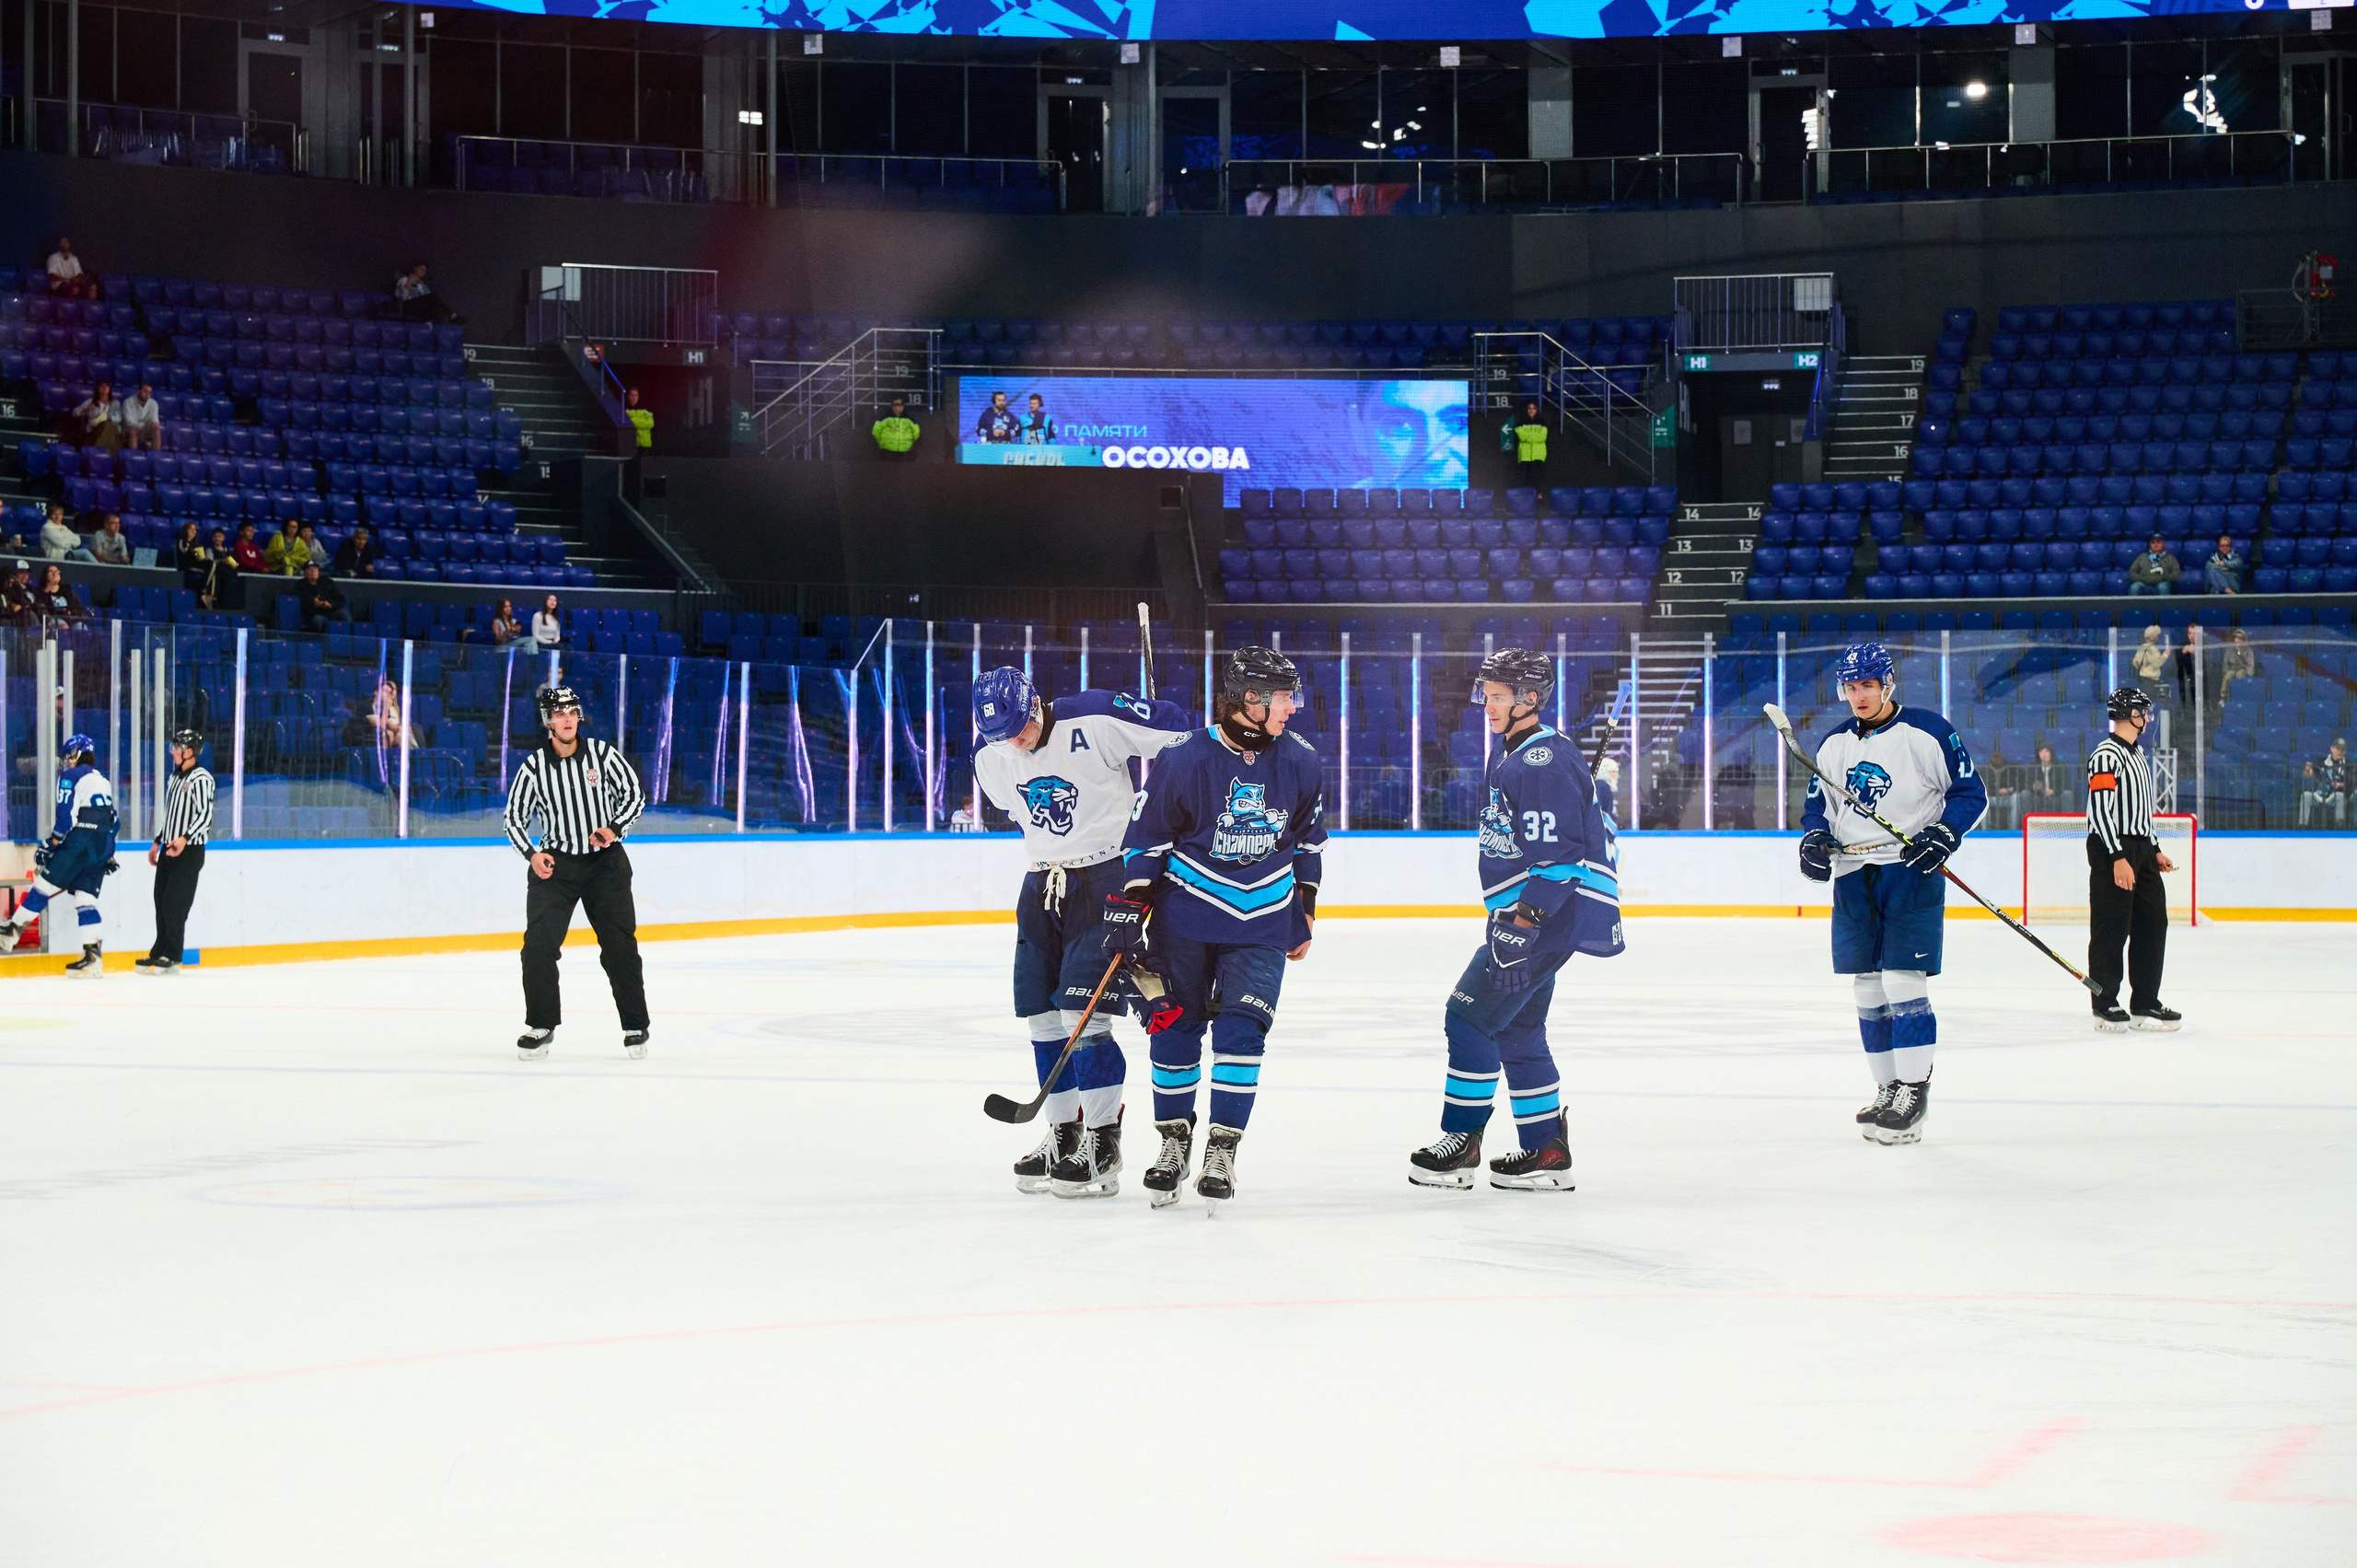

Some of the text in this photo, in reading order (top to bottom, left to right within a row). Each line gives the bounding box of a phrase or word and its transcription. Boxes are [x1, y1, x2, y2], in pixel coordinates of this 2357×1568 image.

[464, 348, 477, 360] 19
[689, 352, 704, 364] H1
[1690, 356, 1707, 369] H1
[1798, 354, 1819, 367] H2
[1910, 358, 1925, 370] 19
[895, 366, 909, 377] 19
[1493, 369, 1507, 379] 19
[908, 393, 922, 405] 18
[1905, 388, 1919, 400] 18
[1495, 396, 1509, 408] 18
[2, 404, 16, 416] 16
[1900, 415, 1914, 427] 17
[1064, 424, 1147, 437] ПАМЯТИ
[521, 435, 534, 447] 16
[1895, 446, 1909, 457] 16
[1102, 446, 1250, 470] ОСОХОВА
[1685, 508, 1700, 520] 14
[1747, 507, 1761, 519] 14
[1677, 540, 1692, 552] 13
[1739, 540, 1754, 552] 13
[1667, 572, 1682, 584] 12
[1731, 571, 1745, 583] 12
[1660, 604, 1672, 616] 11
[983, 703, 994, 717] 68
[1070, 727, 1090, 753] A
[1523, 811, 1559, 842] 32
[1929, 821, 1956, 842] UER
[1103, 911, 1140, 923] UER
[1492, 926, 1527, 947] UER
[1452, 988, 1475, 1005] UER
[1239, 994, 1276, 1019] BAUE
